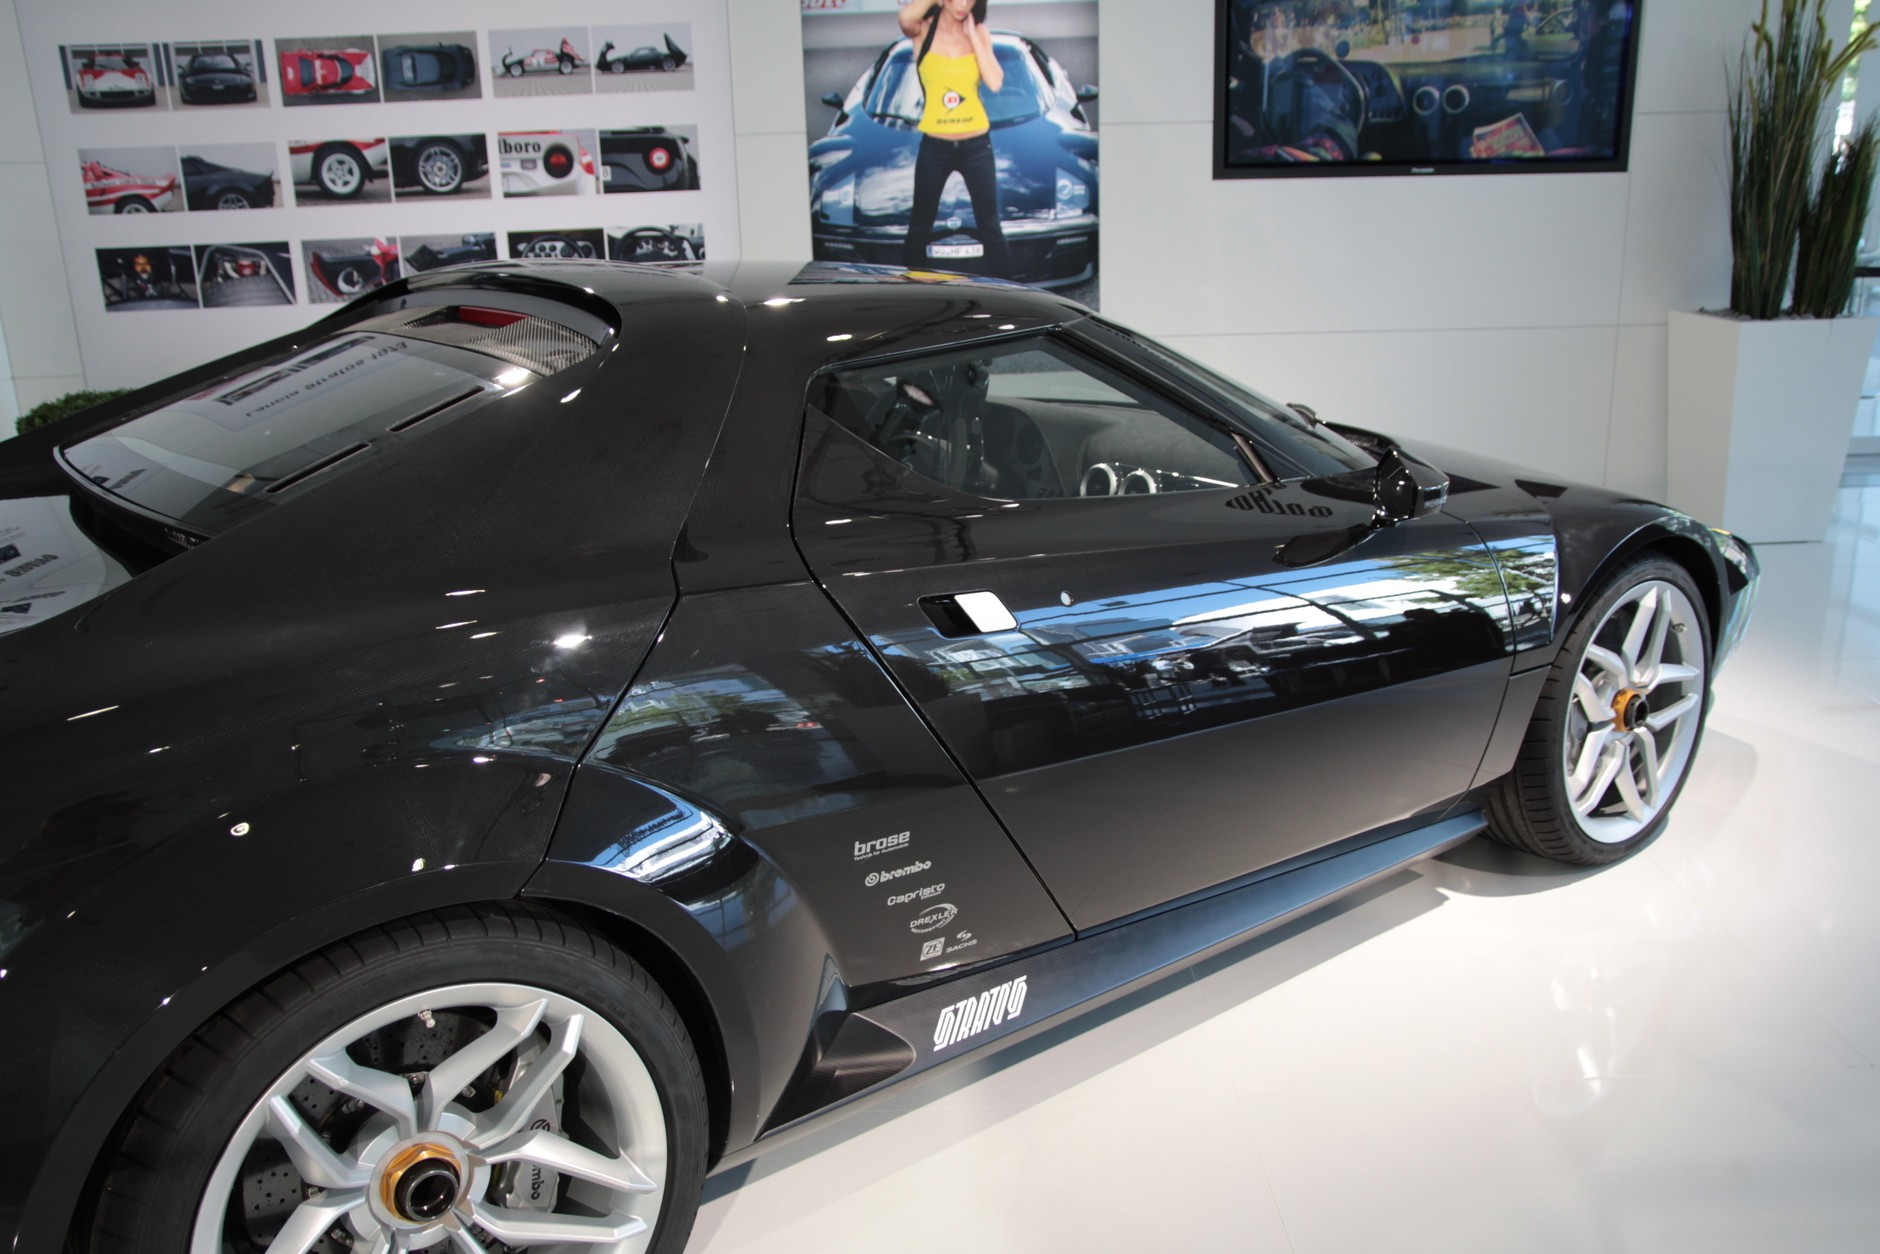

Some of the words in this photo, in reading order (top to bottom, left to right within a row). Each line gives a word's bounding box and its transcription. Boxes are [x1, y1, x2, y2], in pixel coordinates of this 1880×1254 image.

[854, 831, 910, 856] brose
[880, 861, 932, 882] brembo
[887, 883, 945, 906] Capristo
[910, 907, 958, 928] DREXLER
[945, 939, 978, 953] SACHS
